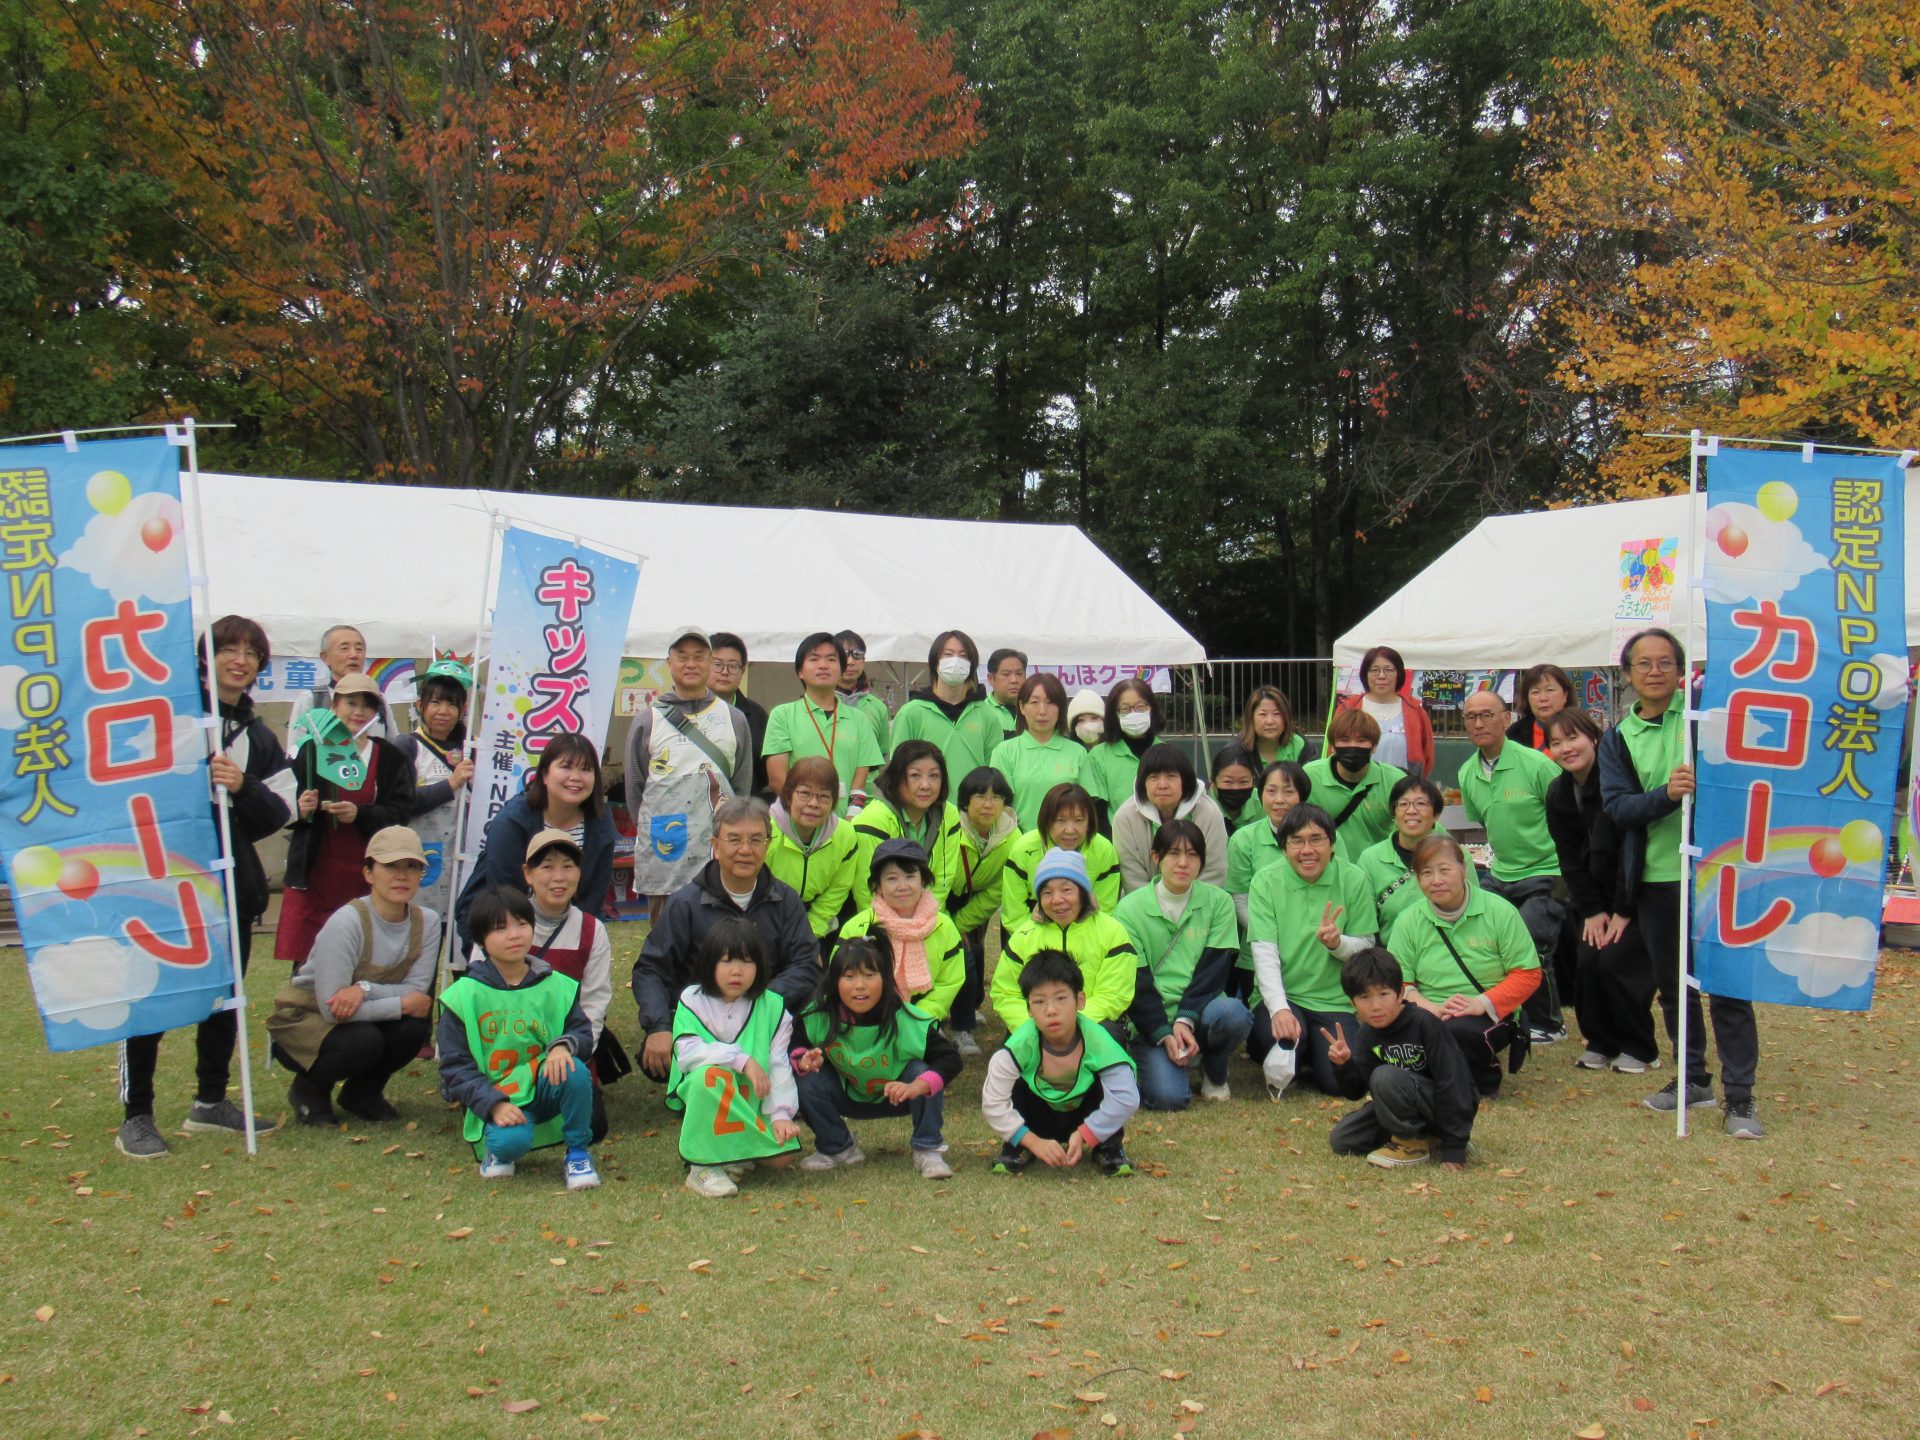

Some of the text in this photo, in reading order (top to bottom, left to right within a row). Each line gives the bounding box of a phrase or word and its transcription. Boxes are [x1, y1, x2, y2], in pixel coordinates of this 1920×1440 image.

[523, 558, 595, 754] キッズ
[1717, 601, 1817, 947] カローレ
[1818, 479, 1884, 801] 認定NPO法人
